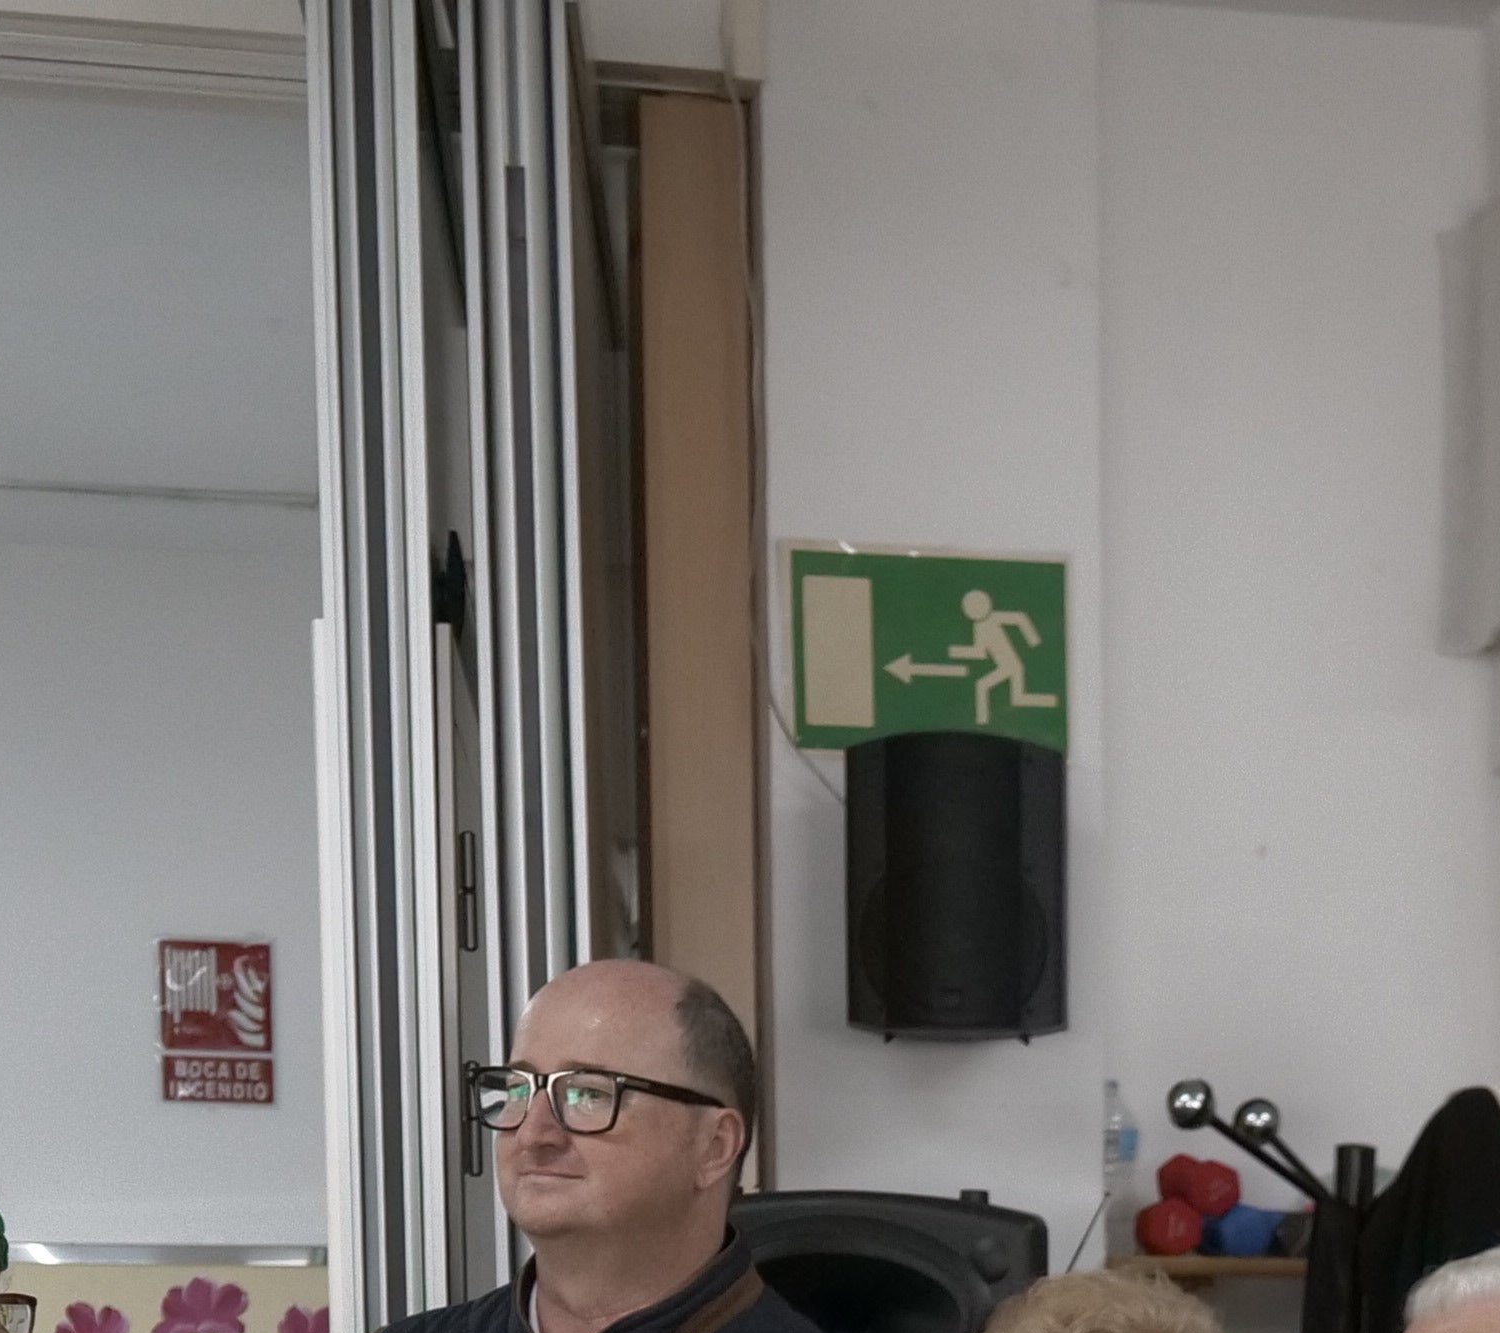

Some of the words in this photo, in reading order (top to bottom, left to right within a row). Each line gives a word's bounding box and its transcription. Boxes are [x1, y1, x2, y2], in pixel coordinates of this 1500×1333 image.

[174, 1060, 231, 1079] BOCA
[235, 1062, 262, 1081] DE
[168, 1081, 268, 1100] INCENDIO
